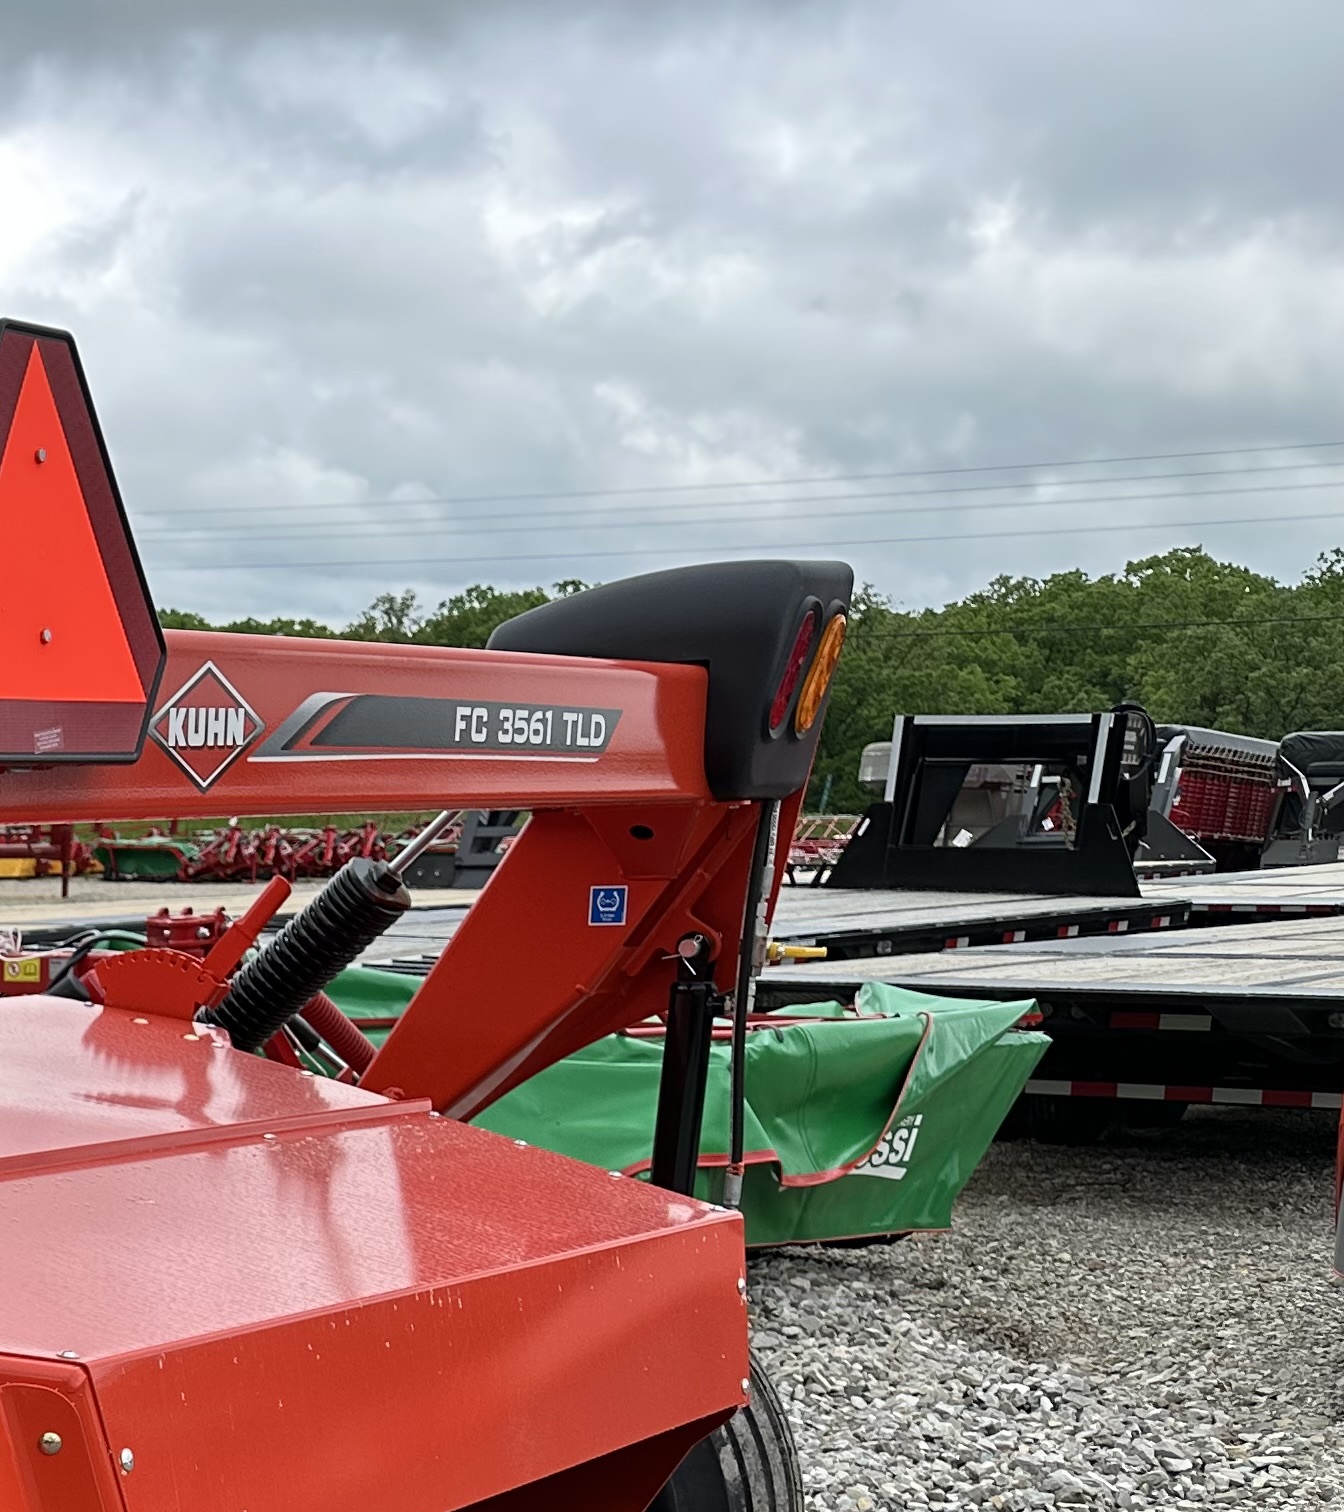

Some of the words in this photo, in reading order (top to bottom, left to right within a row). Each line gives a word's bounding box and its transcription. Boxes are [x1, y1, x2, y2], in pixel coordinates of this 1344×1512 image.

[168, 707, 245, 748] KUHN
[454, 706, 489, 743] FC
[497, 709, 553, 745] 3561
[562, 712, 607, 748] TLD
[855, 1113, 923, 1166] ssi
